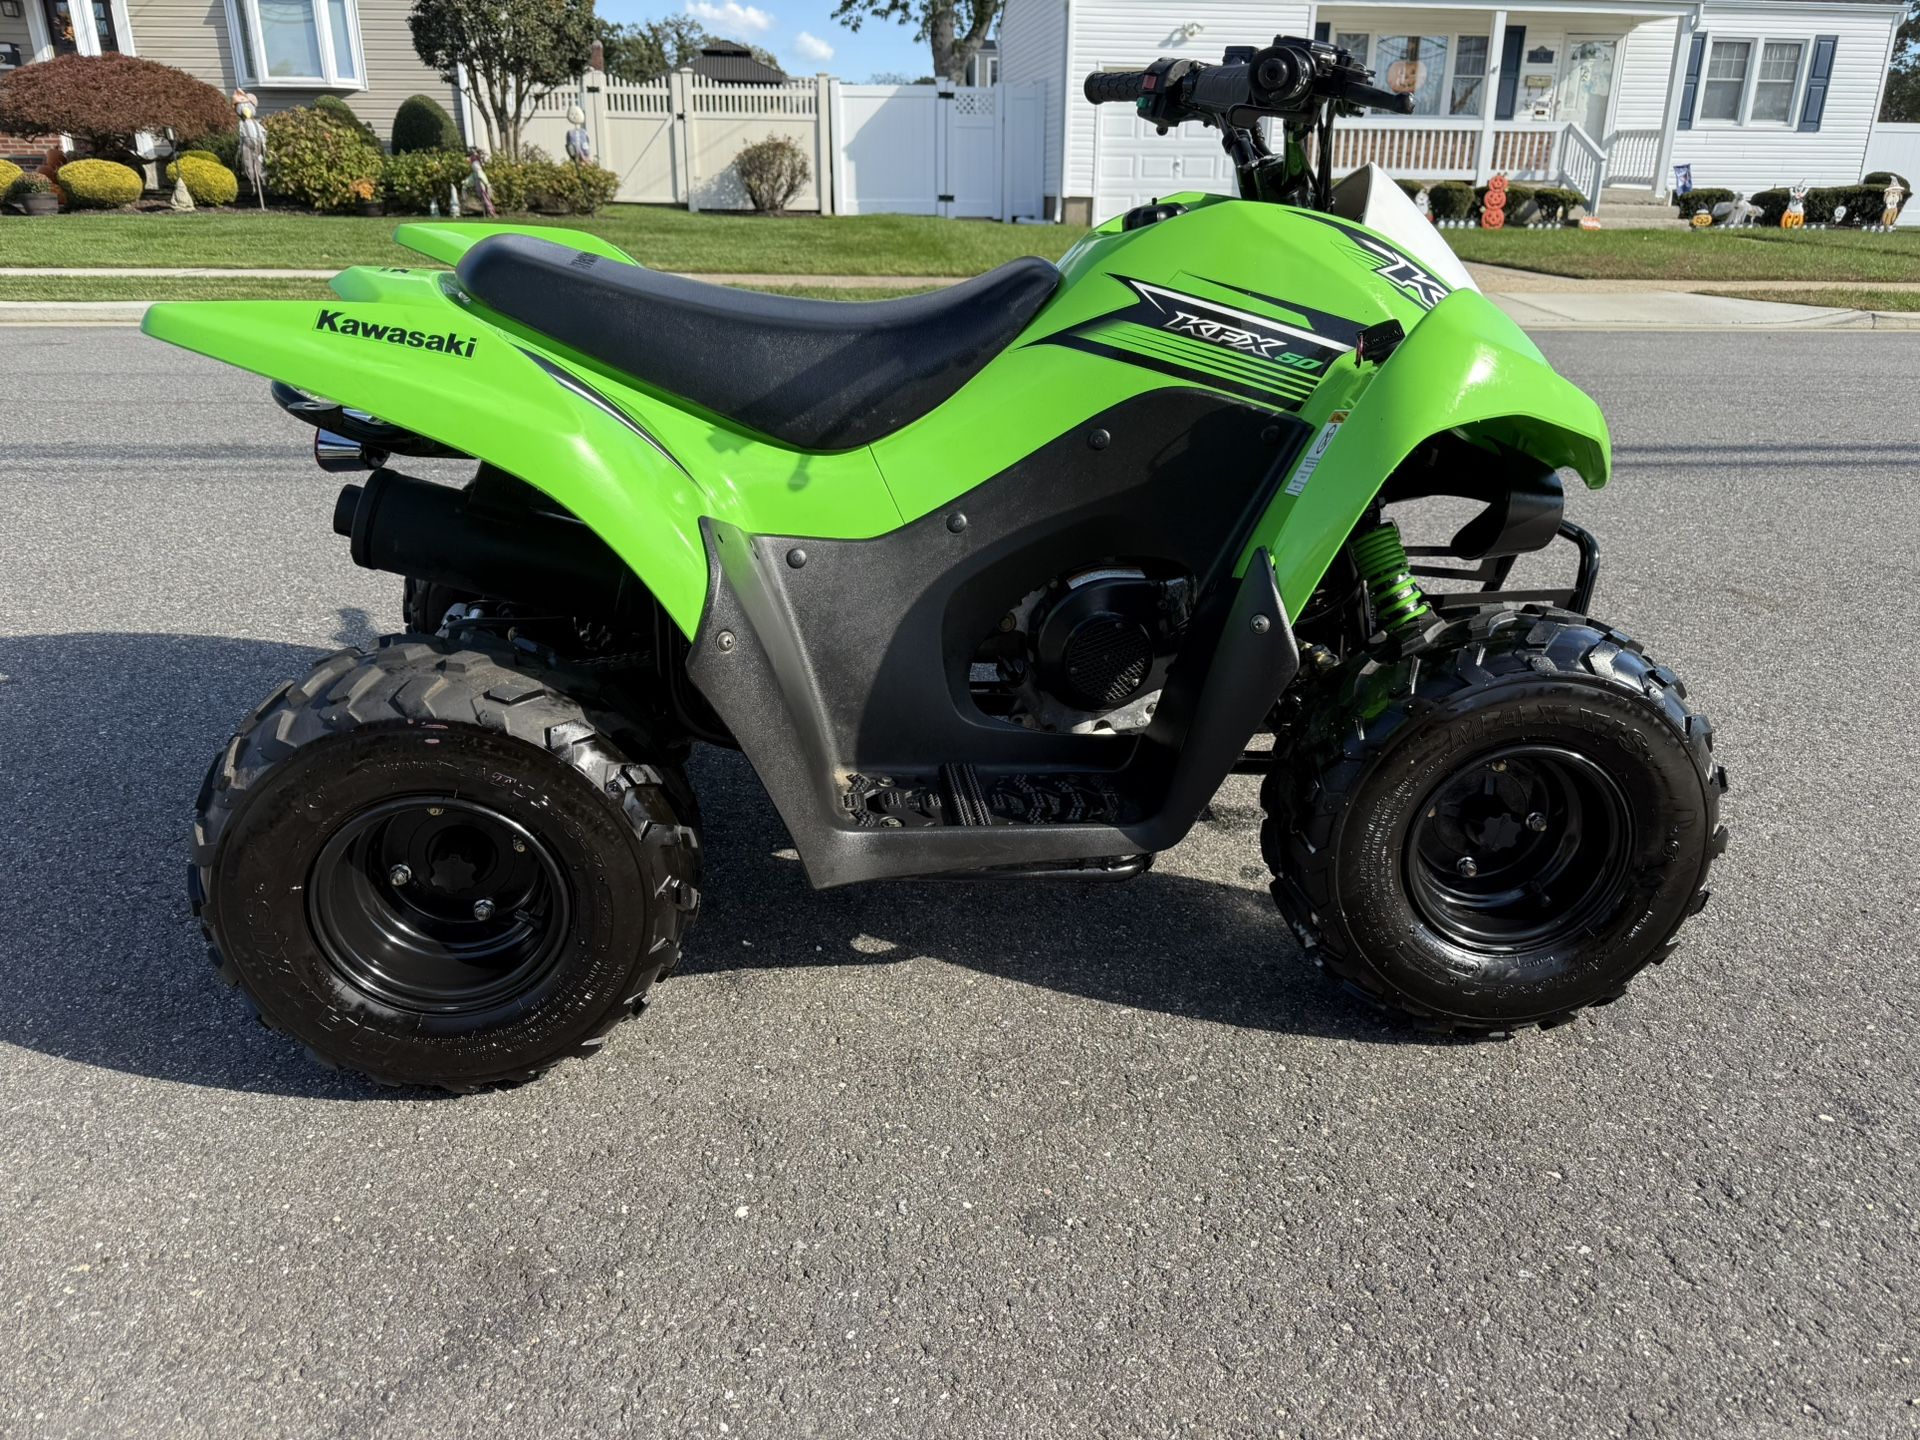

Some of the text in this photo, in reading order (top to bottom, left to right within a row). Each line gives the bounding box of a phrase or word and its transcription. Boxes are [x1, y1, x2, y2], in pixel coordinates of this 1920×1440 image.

[315, 309, 478, 358] Kawasaki
[1163, 310, 1324, 370] KFX 50
